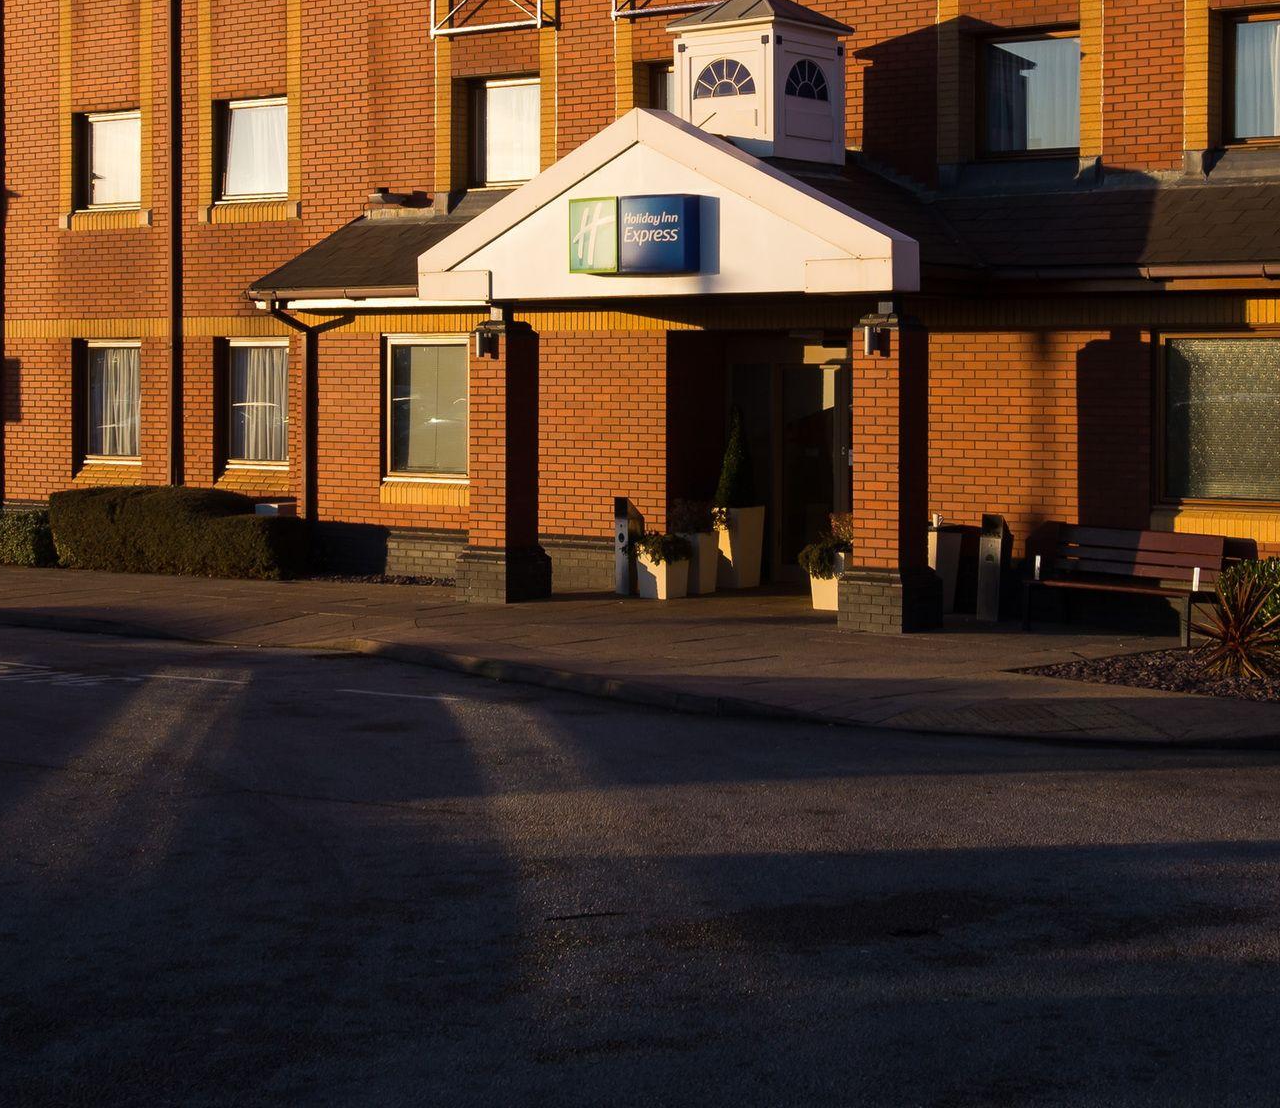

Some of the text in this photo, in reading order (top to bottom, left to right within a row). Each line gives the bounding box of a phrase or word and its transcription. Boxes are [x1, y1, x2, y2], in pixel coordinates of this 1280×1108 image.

[624, 211, 678, 226] Holiday Inn
[624, 227, 679, 247] Express
